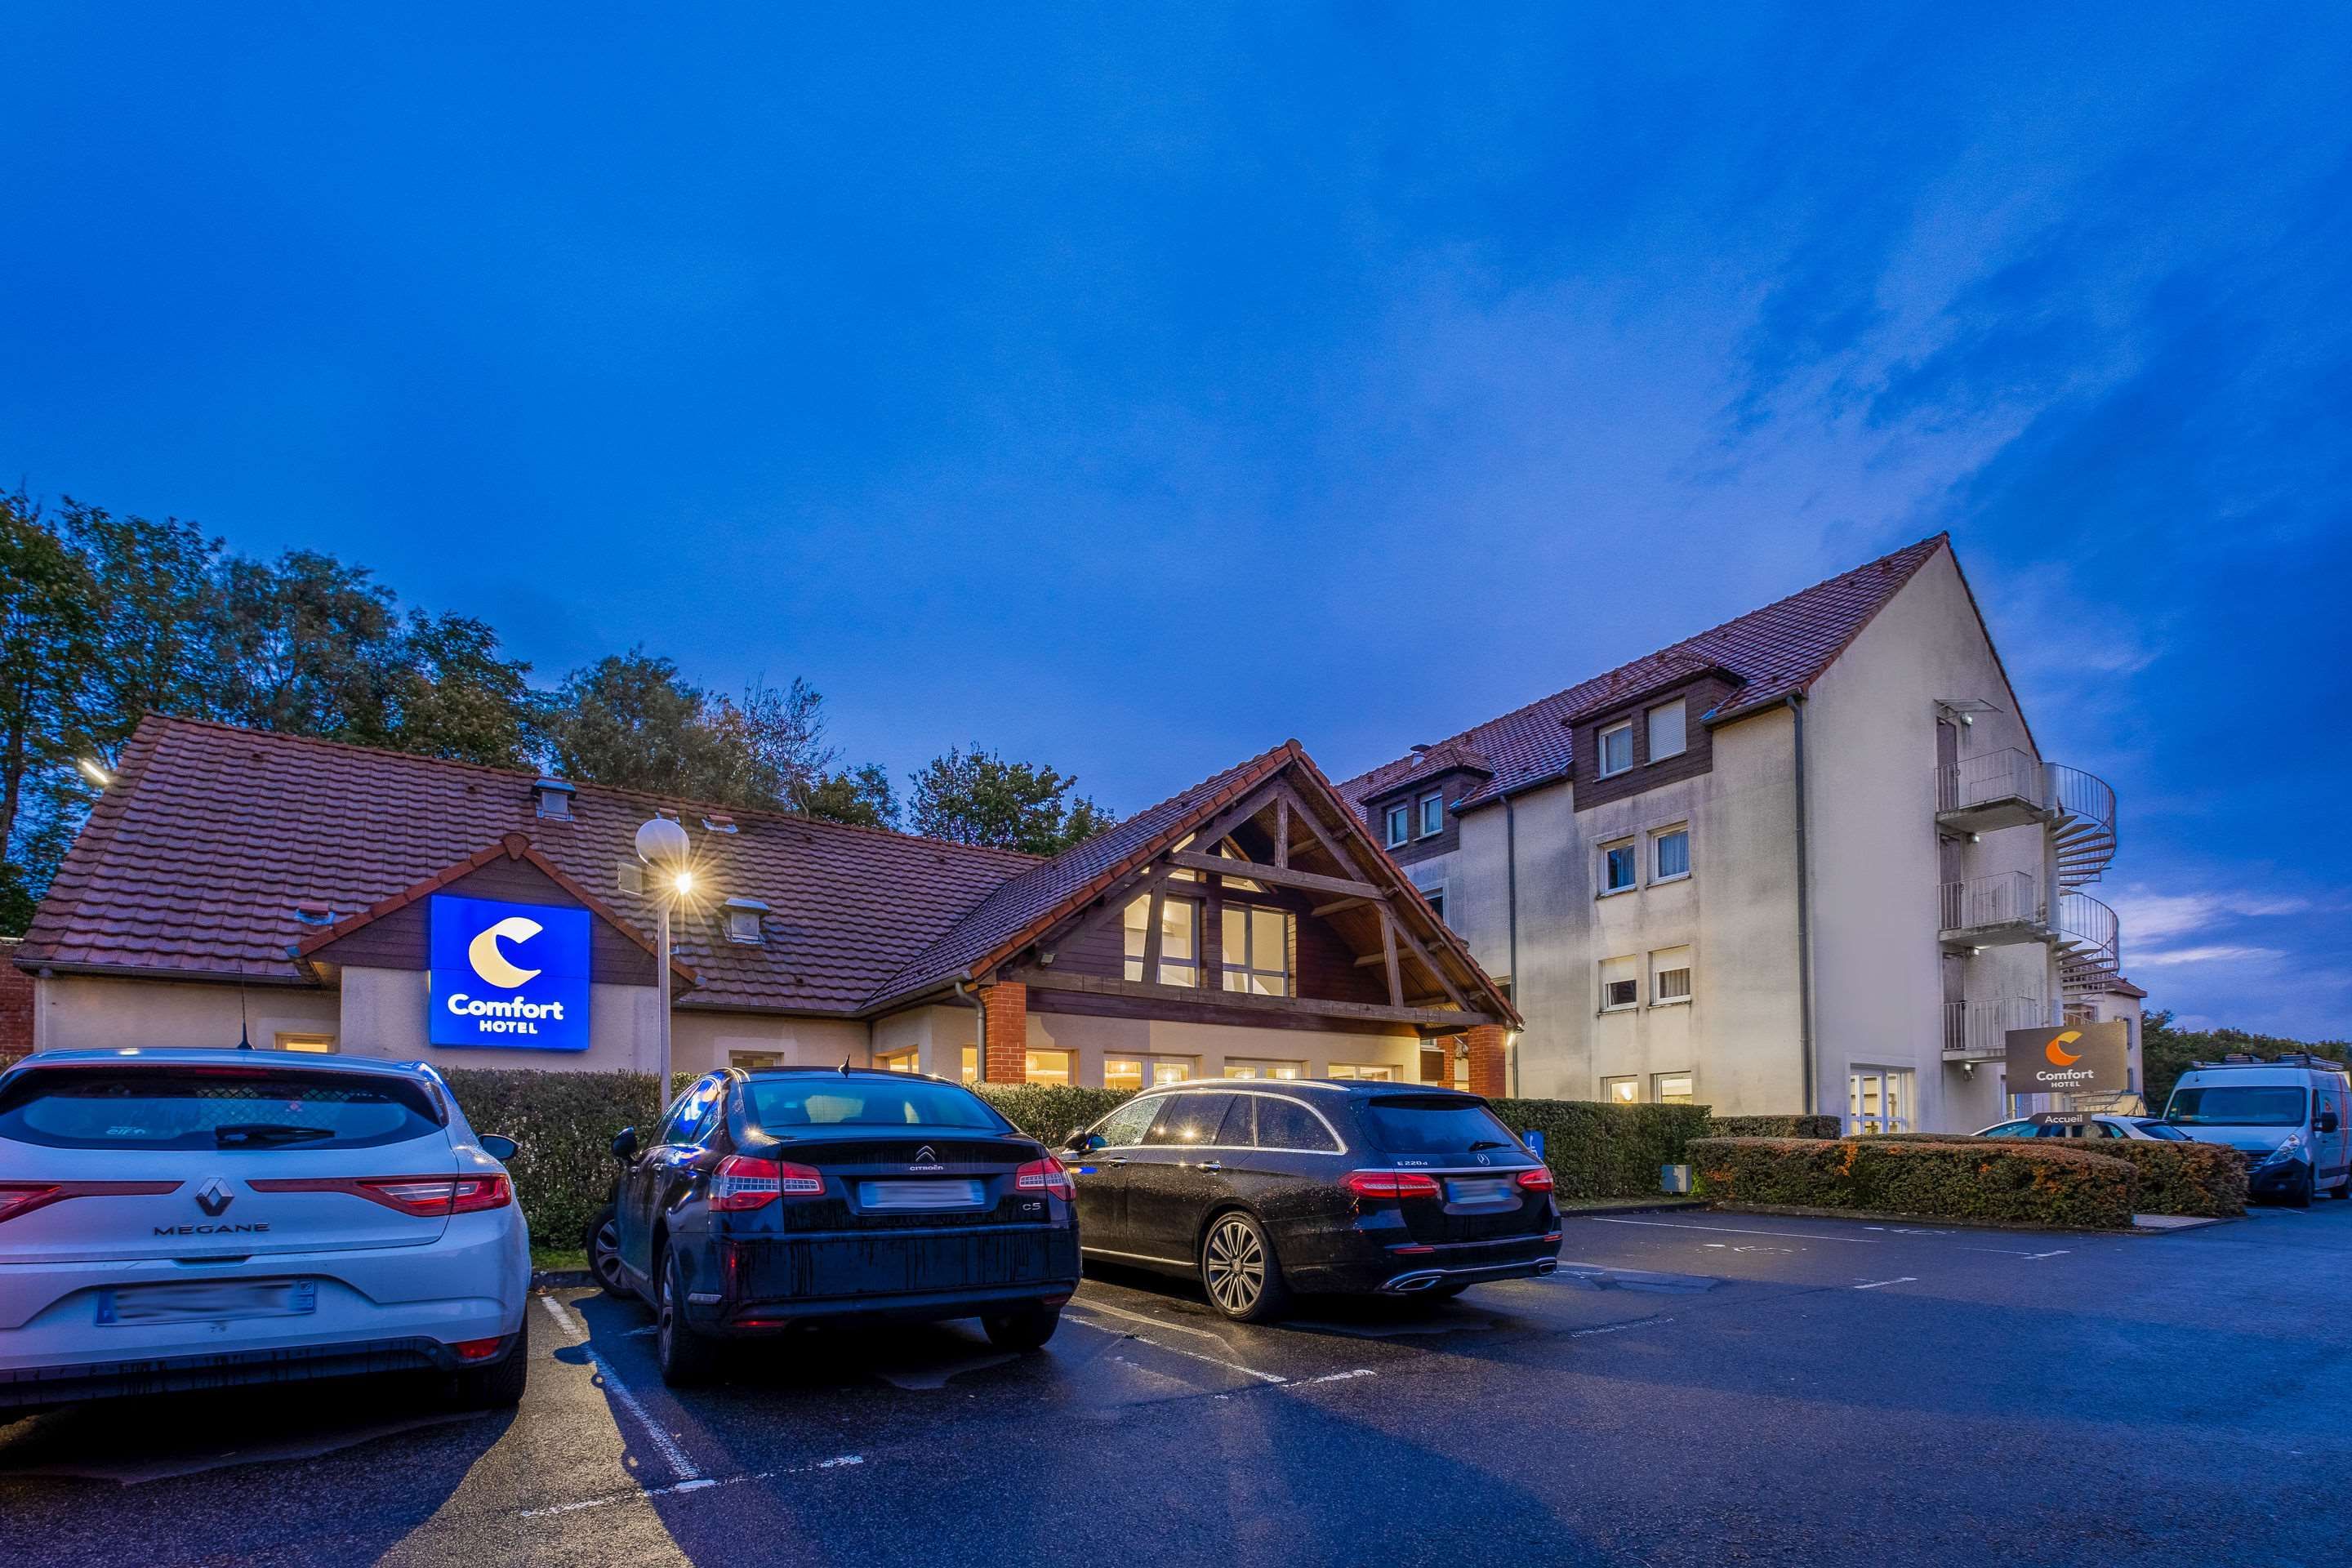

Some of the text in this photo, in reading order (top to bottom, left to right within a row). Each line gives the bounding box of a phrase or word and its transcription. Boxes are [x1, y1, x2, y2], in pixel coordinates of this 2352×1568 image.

[448, 993, 564, 1020] Comfort
[479, 1019, 538, 1035] HOTEL
[2036, 1069, 2095, 1081] Comfort
[2044, 1114, 2083, 1124] Accueil
[1022, 1202, 1041, 1210] C5
[154, 1223, 270, 1236] MEGANE
